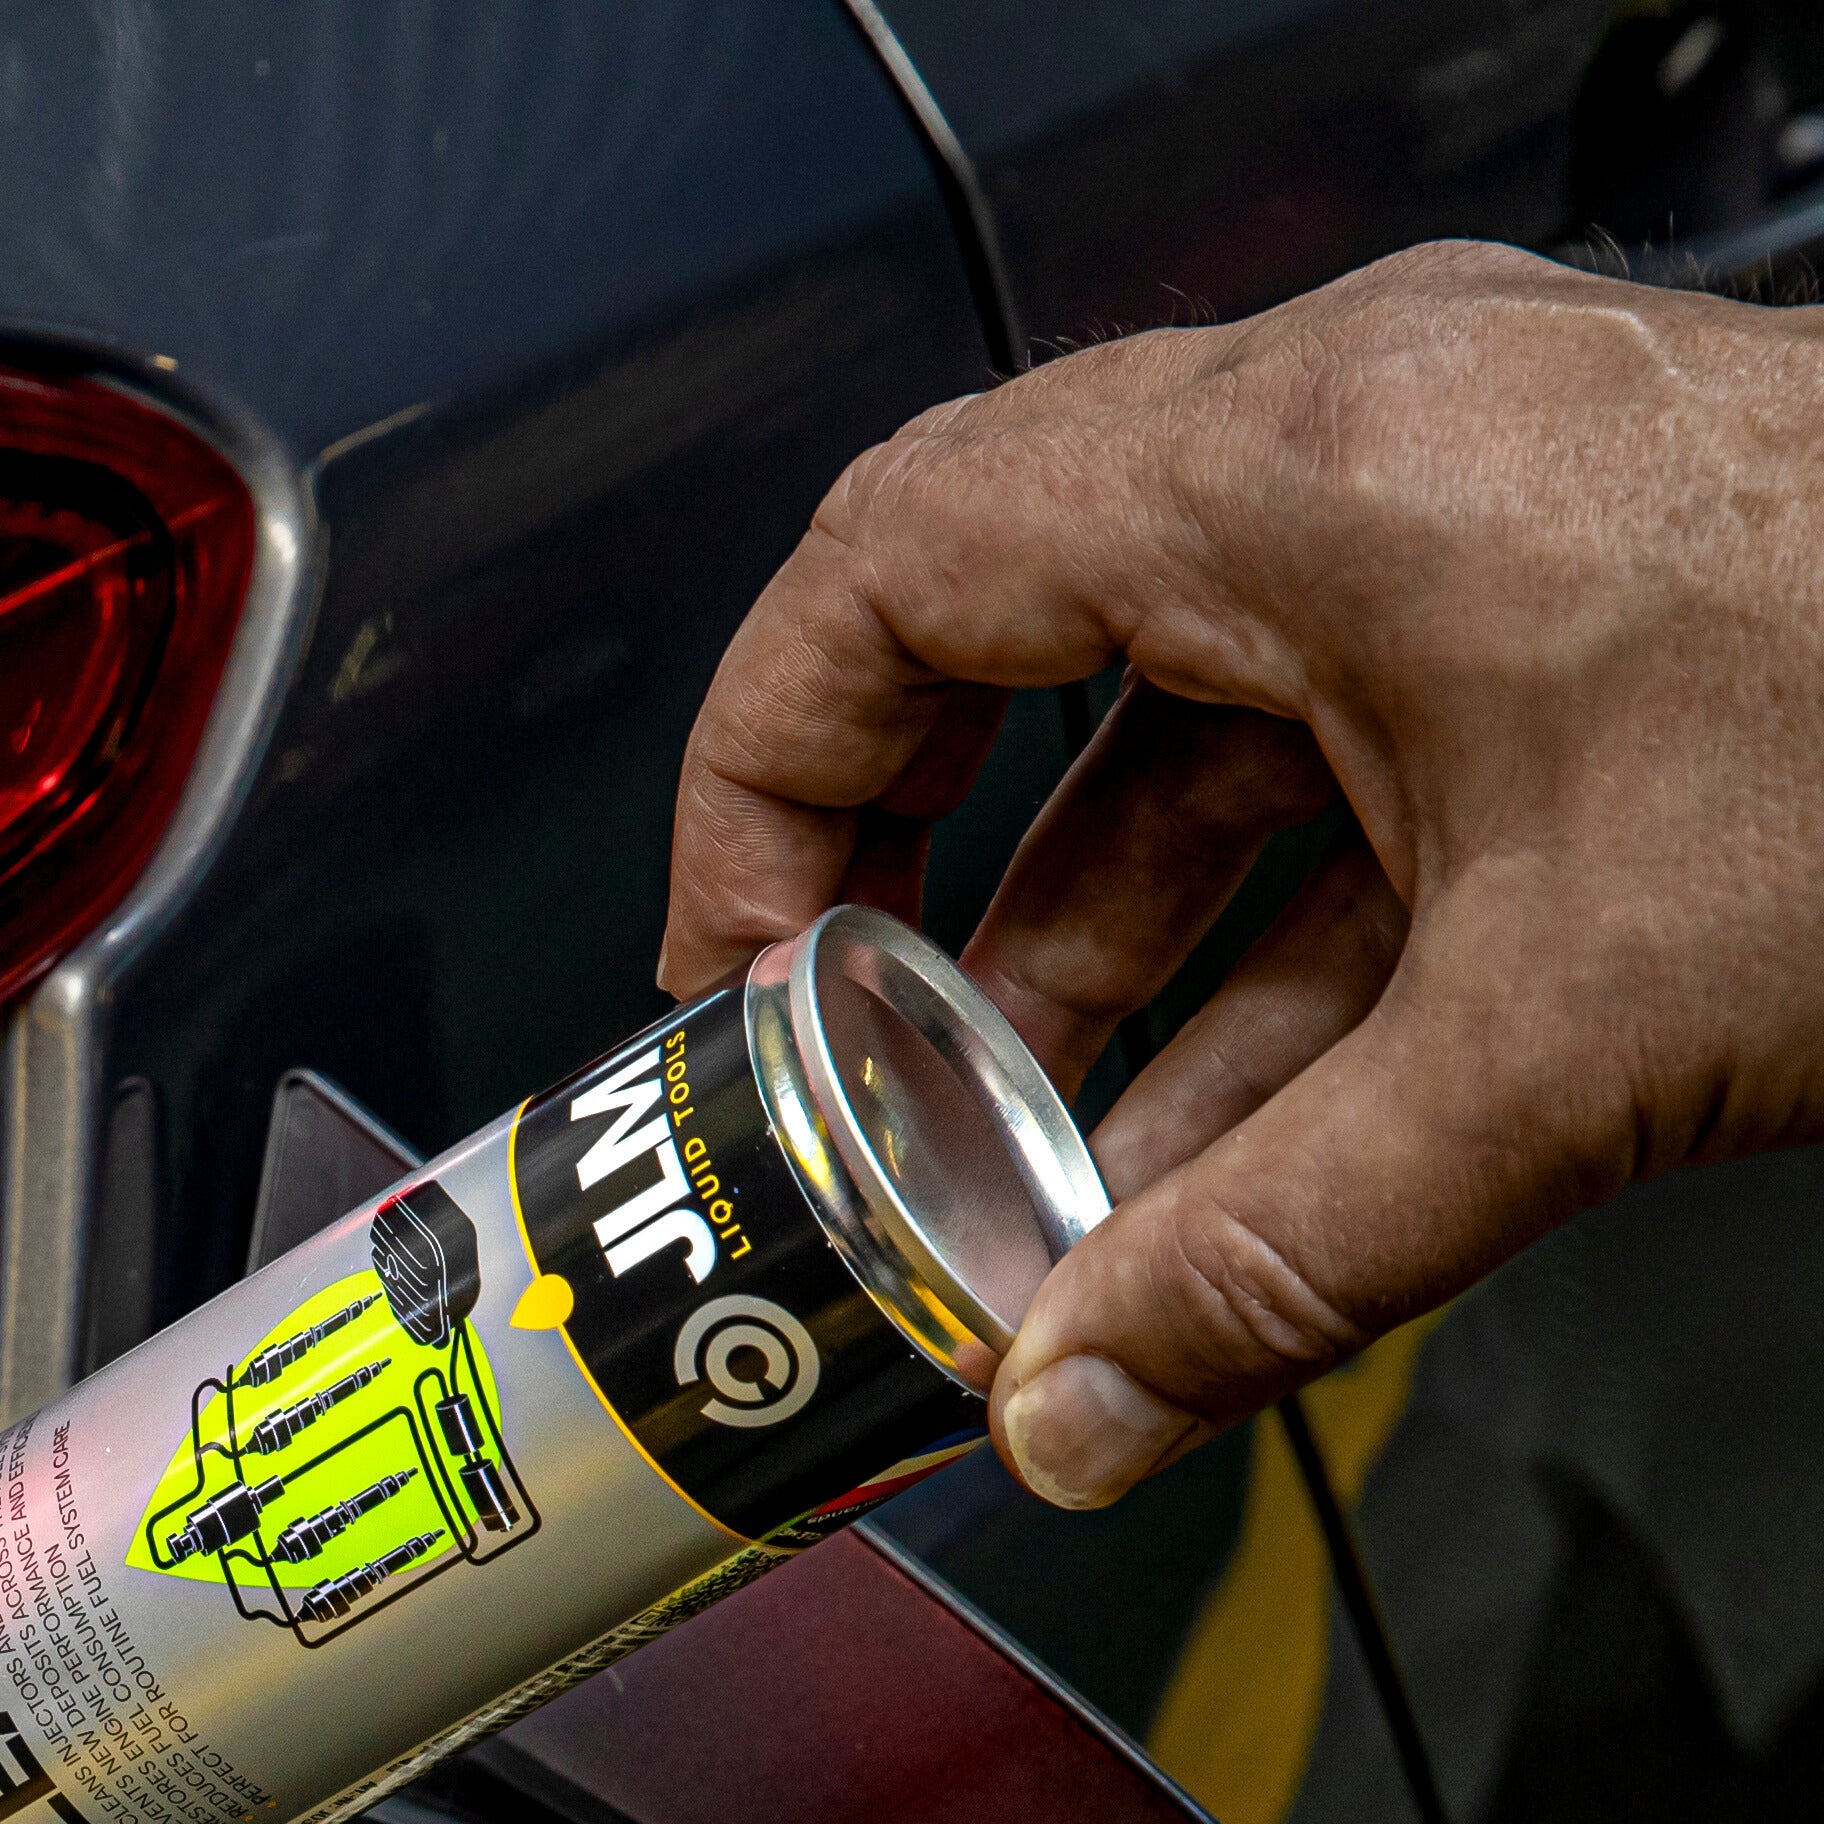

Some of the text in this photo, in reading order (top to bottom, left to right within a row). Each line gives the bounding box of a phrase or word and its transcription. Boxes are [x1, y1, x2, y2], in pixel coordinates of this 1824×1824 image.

[570, 1044, 719, 1286] JLM
[665, 1030, 754, 1261] LIQUID TOOLS
[8, 1481, 27, 1521] AND
[14, 1524, 90, 1684] PERFORMANCE
[52, 1419, 273, 1806] PERFECT FOR ROUTINE FUEL SYSTEM CARE
[7, 1657, 83, 1768] INJECTORS
[19, 1624, 86, 1728] DEPOSITS
[44, 1543, 249, 1819] REDUCES FUEL CONSUMPTION
[81, 1685, 145, 1762] ENGINE
[77, 1730, 122, 1775] NEW
